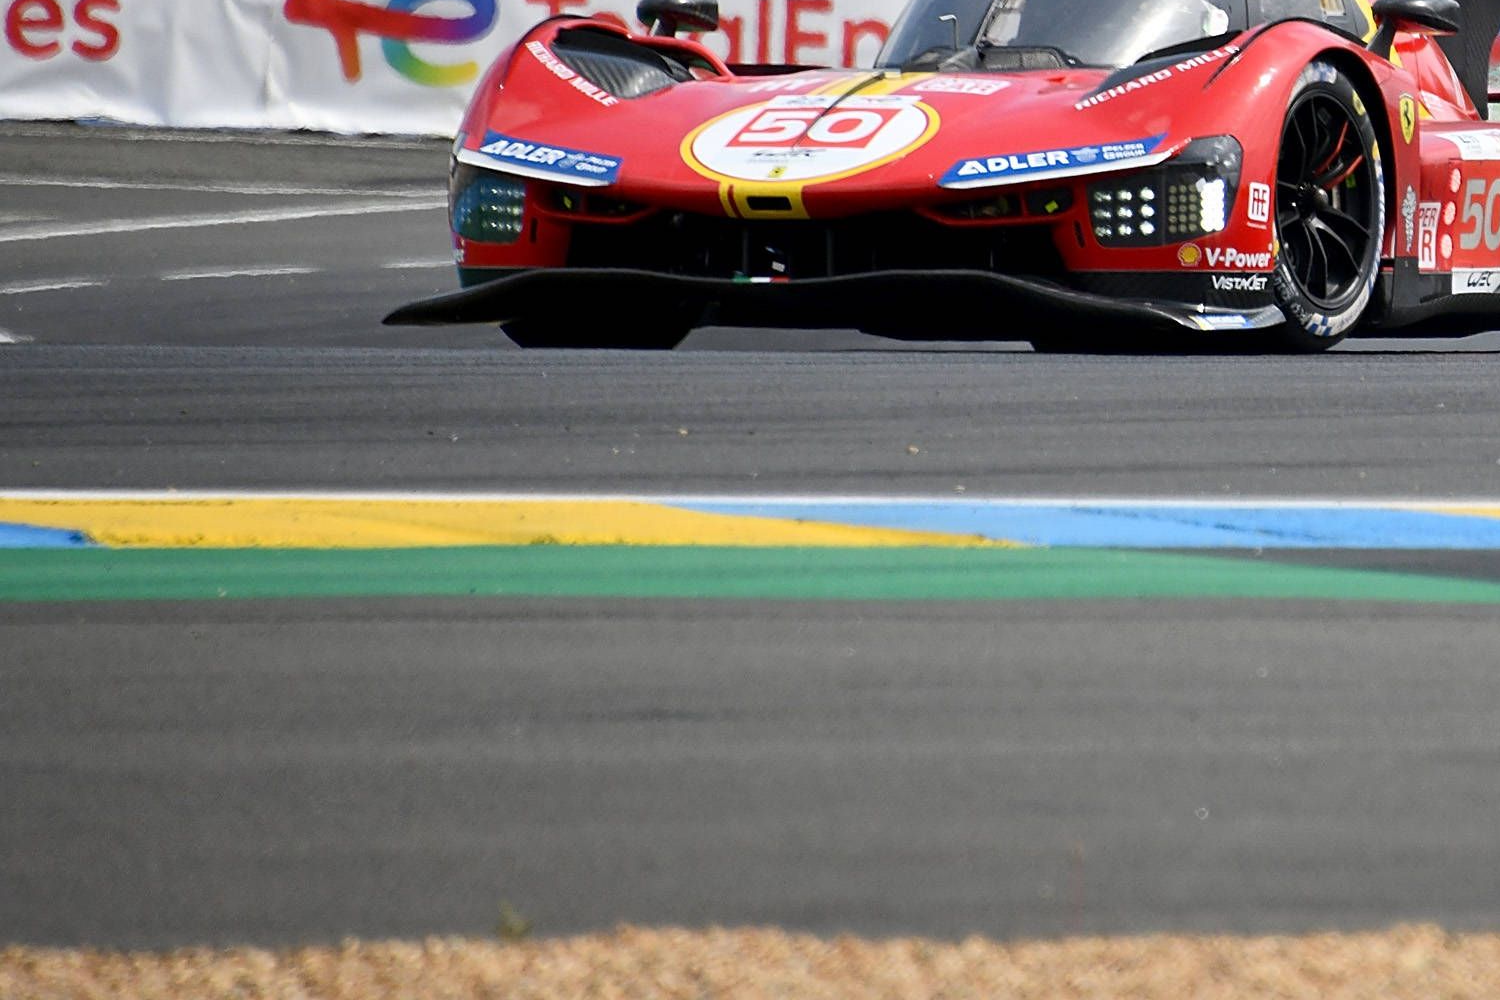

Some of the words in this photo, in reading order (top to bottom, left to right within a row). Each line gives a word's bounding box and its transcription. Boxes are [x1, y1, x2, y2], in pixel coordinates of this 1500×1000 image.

[738, 109, 884, 142] 50
[480, 139, 565, 167] ADLER
[957, 150, 1069, 176] ADLER
[1205, 247, 1272, 267] V-Power
[1467, 271, 1494, 287] WEC
